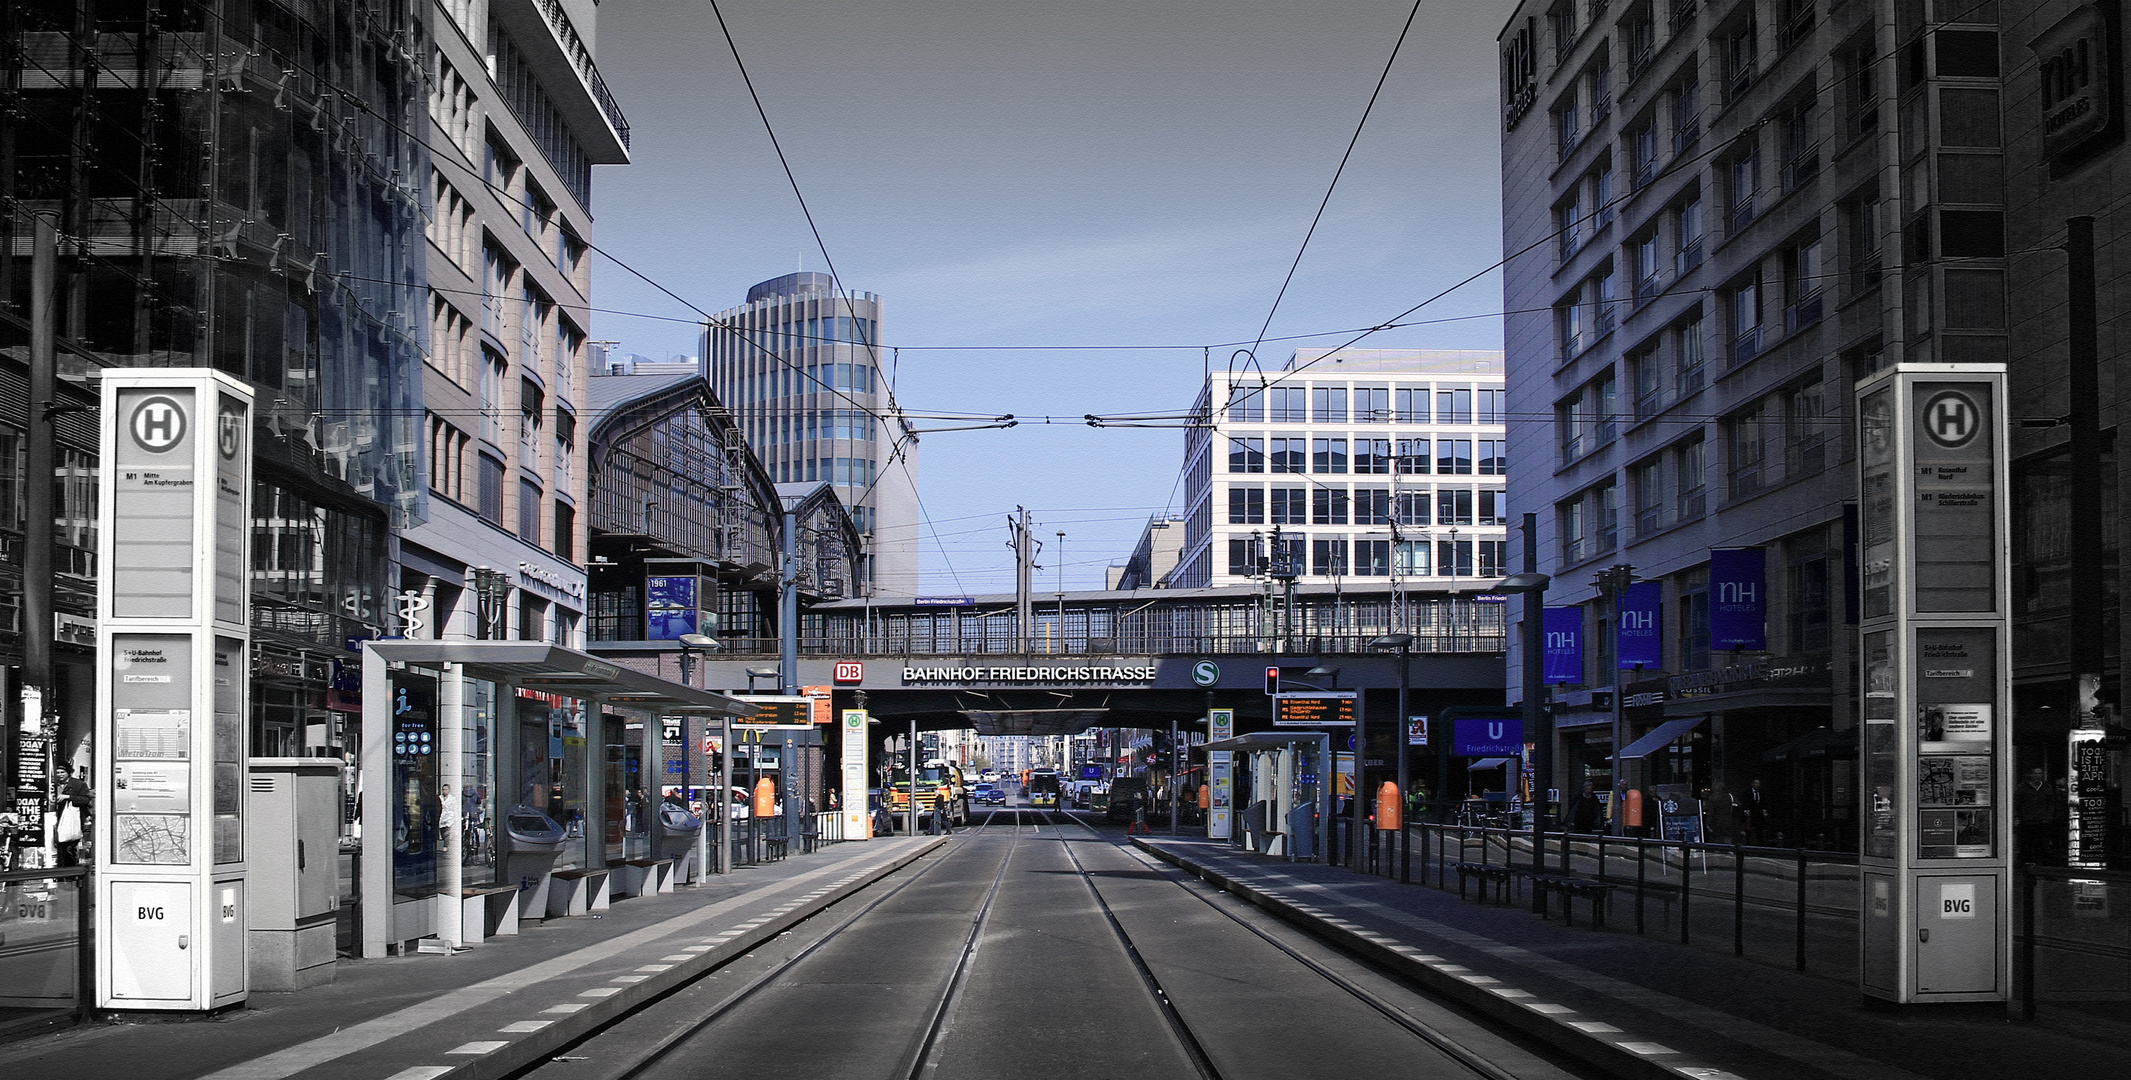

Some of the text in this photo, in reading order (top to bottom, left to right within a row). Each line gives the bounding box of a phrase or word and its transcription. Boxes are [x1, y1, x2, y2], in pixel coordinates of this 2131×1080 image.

[650, 579, 667, 588] 1961
[1718, 581, 1755, 603] nH
[1719, 604, 1756, 612] HOTELES
[1621, 610, 1653, 629] nH
[1546, 631, 1575, 648] nH
[1621, 629, 1654, 637] HOTELES
[1924, 651, 1969, 659] Friedrichstraße
[839, 665, 860, 679] DB
[903, 666, 1156, 681] BAHNHOF FRIEDRICHSTRASSE
[1488, 722, 1504, 740] U
[120, 750, 165, 759] MetroTram
[138, 906, 165, 920] BVG
[222, 904, 235, 919] BVG
[1943, 899, 1971, 913] BVG
